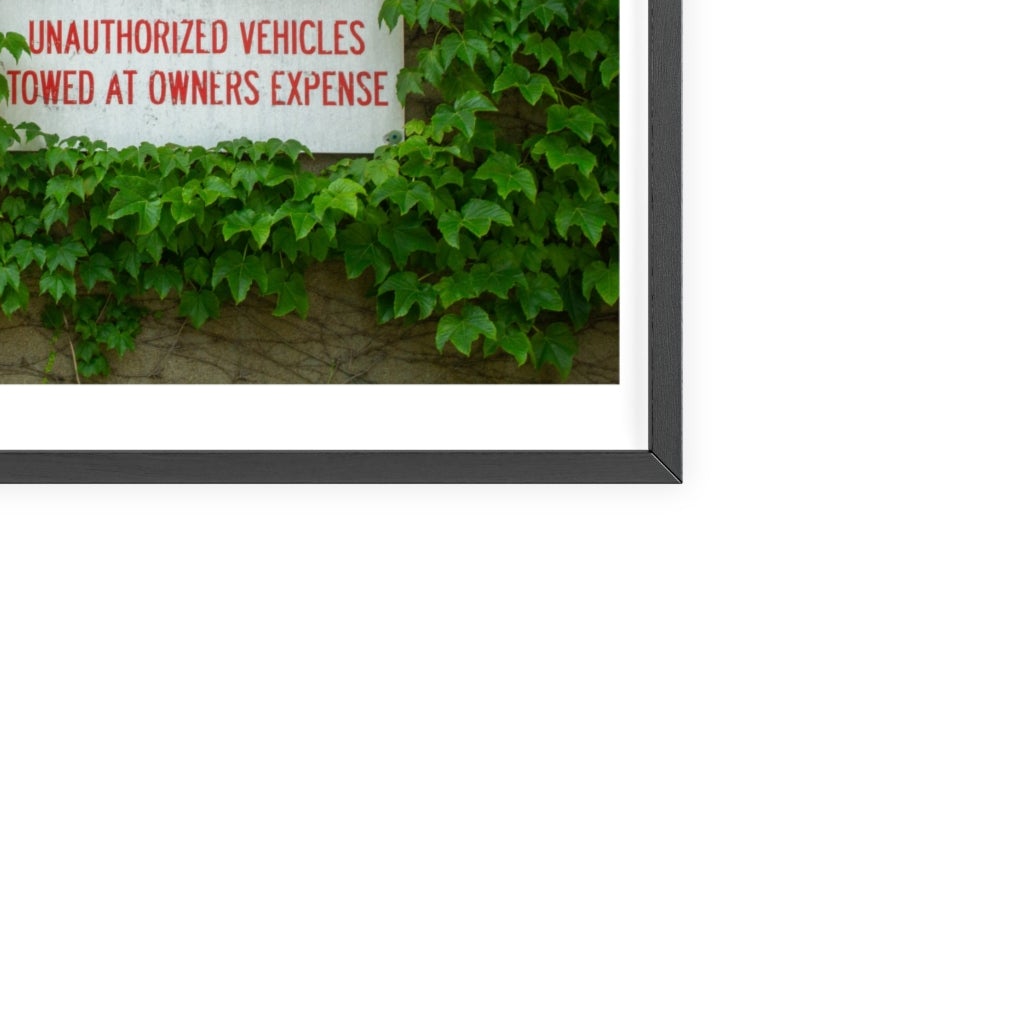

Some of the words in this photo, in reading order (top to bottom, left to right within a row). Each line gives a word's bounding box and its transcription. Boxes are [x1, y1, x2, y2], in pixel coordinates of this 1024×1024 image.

[29, 18, 228, 55] UNAUTHORIZED
[240, 19, 366, 55] VEHICLES
[7, 69, 95, 106] TOWED
[105, 69, 138, 106] AT
[148, 69, 260, 106] OWNERS
[271, 70, 389, 106] EXPENSE
